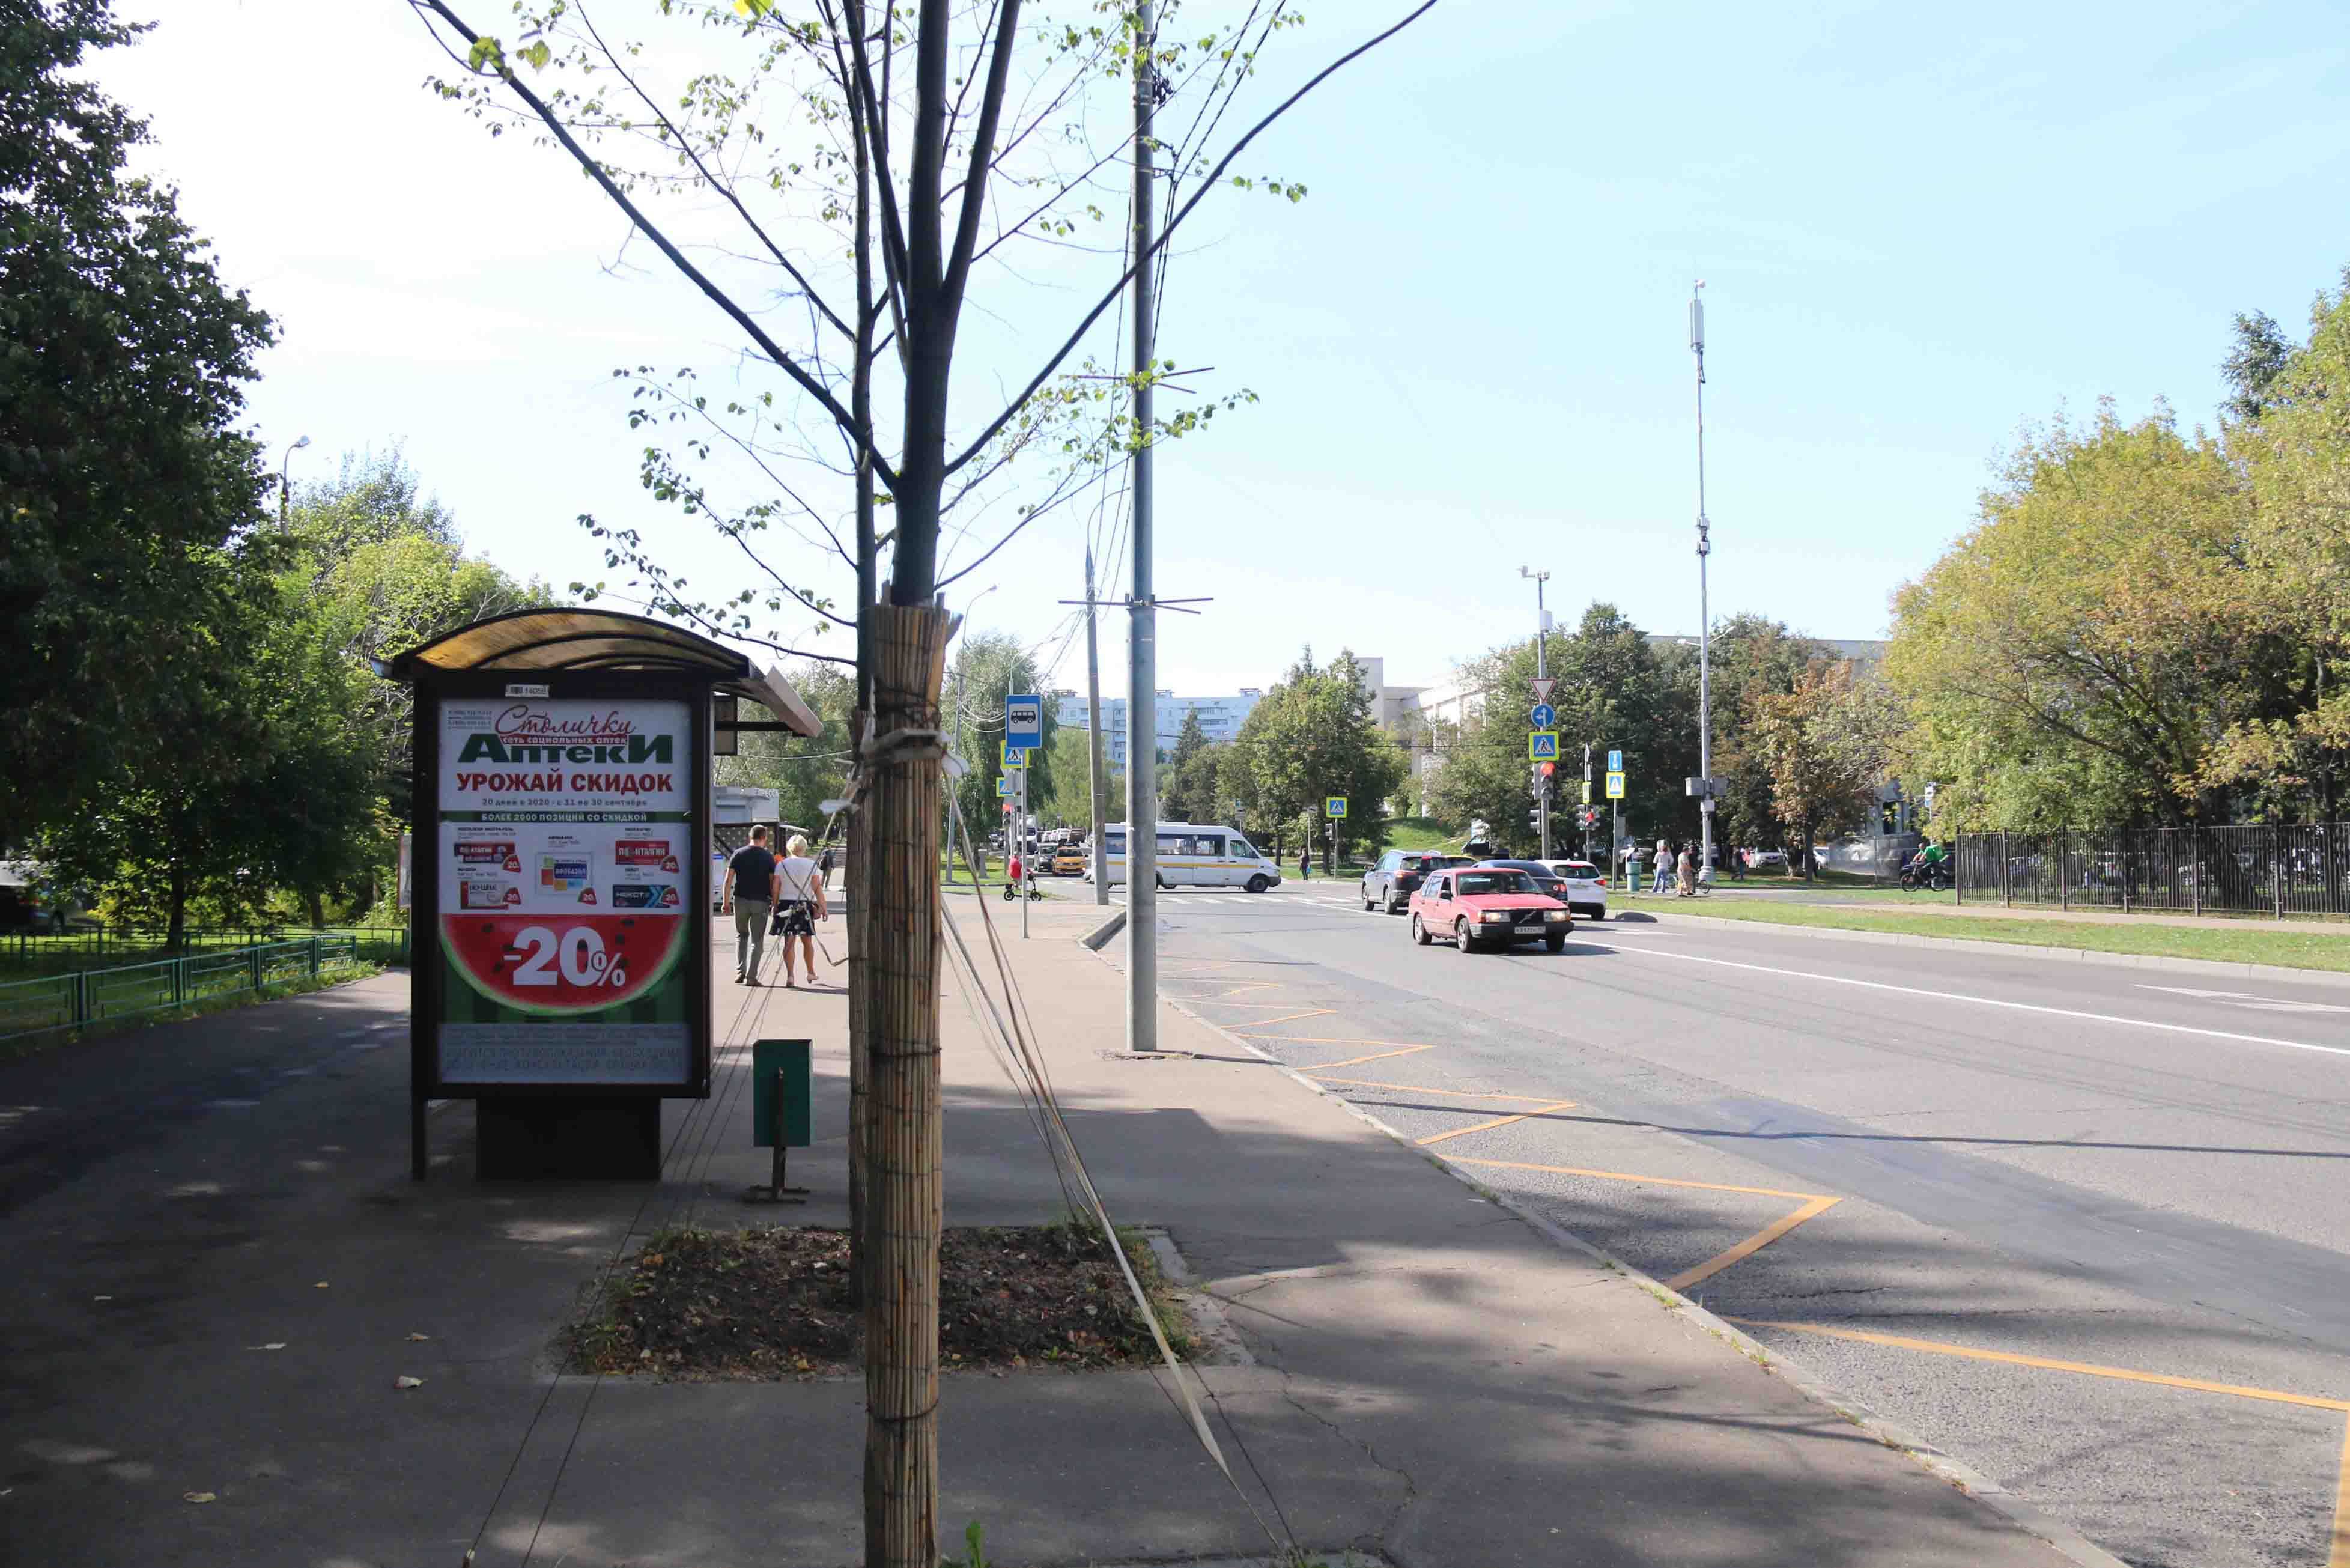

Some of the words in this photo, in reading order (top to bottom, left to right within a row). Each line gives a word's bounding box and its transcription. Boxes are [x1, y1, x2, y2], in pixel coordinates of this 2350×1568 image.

[495, 704, 637, 735] Столички
[528, 735, 593, 744] социальных
[456, 768, 563, 792] УРОЖАЙ
[570, 773, 673, 796] СКИДОК
[539, 812, 584, 822] ПОЗИЦИЙ
[603, 812, 647, 822] СКИДКОЙ
[503, 926, 625, 987] -20%
